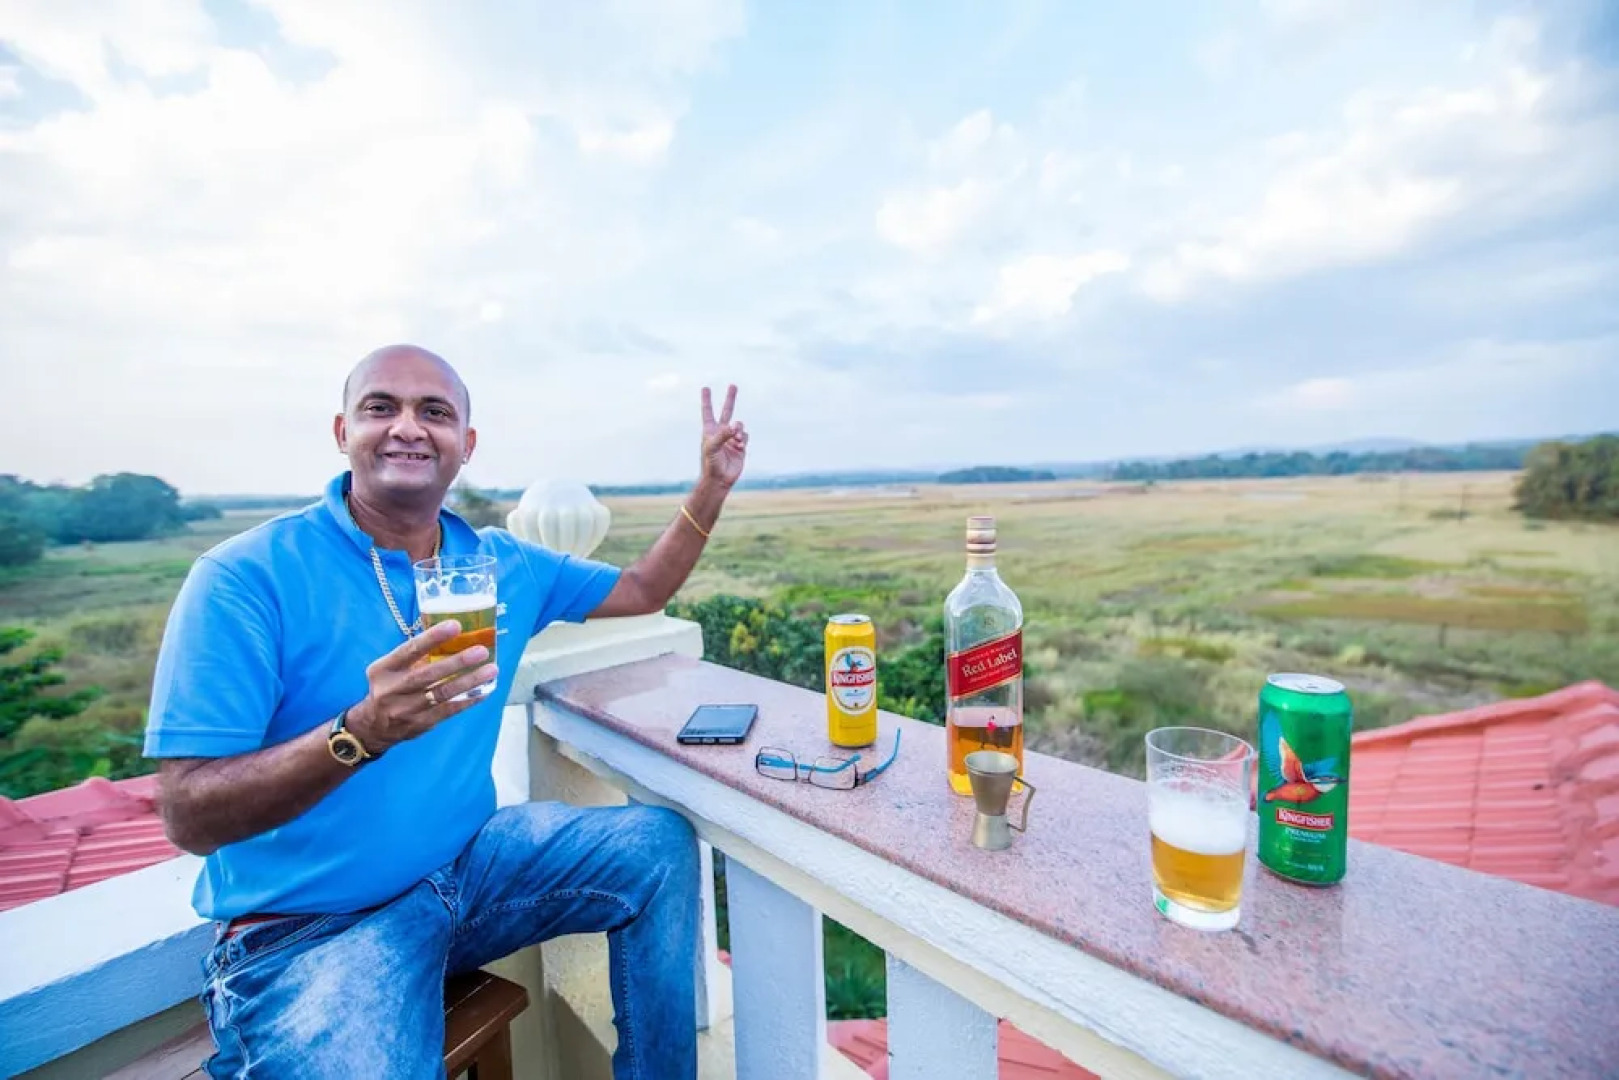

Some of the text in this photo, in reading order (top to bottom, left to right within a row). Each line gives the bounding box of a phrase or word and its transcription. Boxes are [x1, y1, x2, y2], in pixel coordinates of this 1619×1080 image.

[962, 660, 987, 678] Red
[987, 648, 1018, 668] Label
[1278, 808, 1332, 827] KINGFISHER
